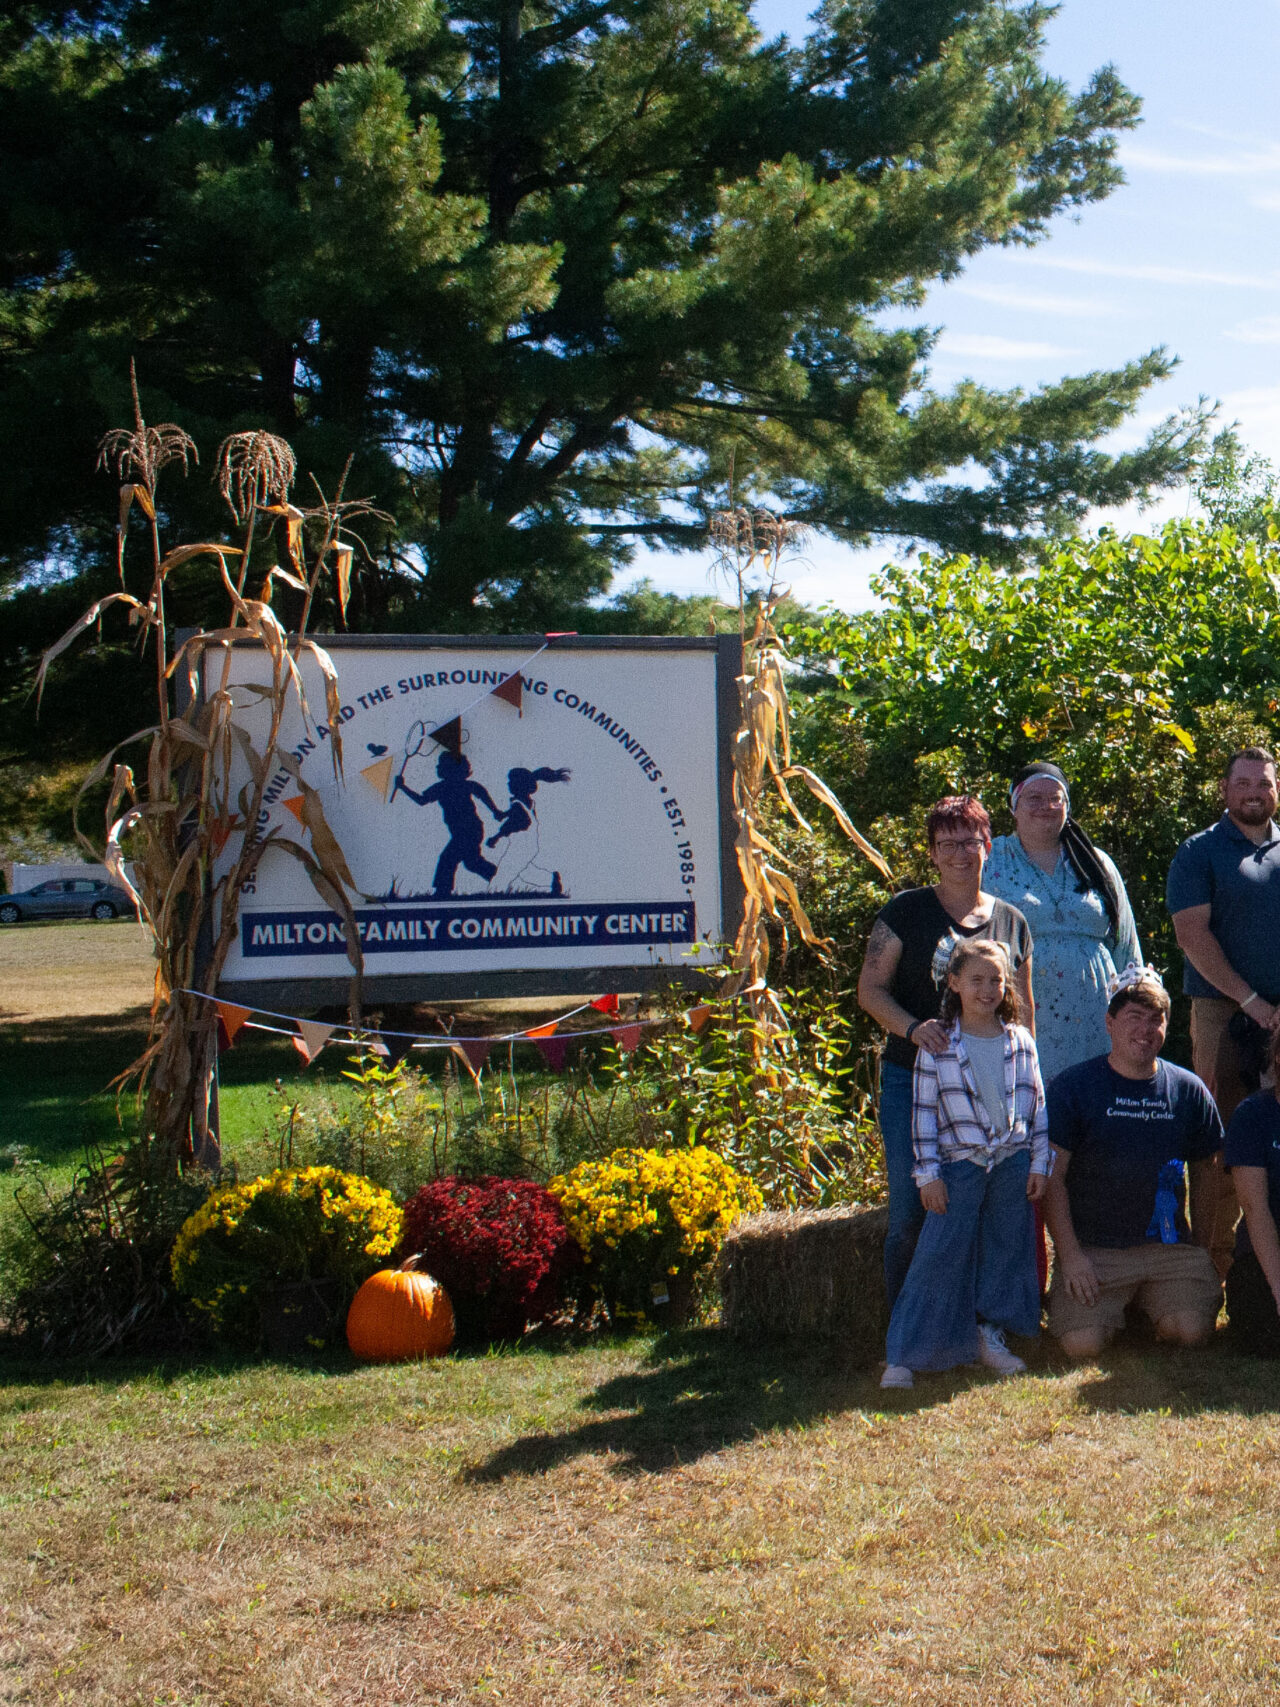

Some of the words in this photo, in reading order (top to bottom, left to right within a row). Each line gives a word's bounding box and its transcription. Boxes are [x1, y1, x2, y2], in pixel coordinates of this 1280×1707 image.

[357, 685, 394, 710] THE
[398, 669, 549, 696] SURROUNNG
[553, 689, 663, 783] COMMUNITIES
[663, 798, 686, 836] EST.
[678, 841, 696, 886] 1985
[252, 921, 348, 945] MILTON
[357, 919, 441, 942] FAMILY
[448, 915, 599, 939] COMMUNITY
[605, 913, 687, 935] CENTER
